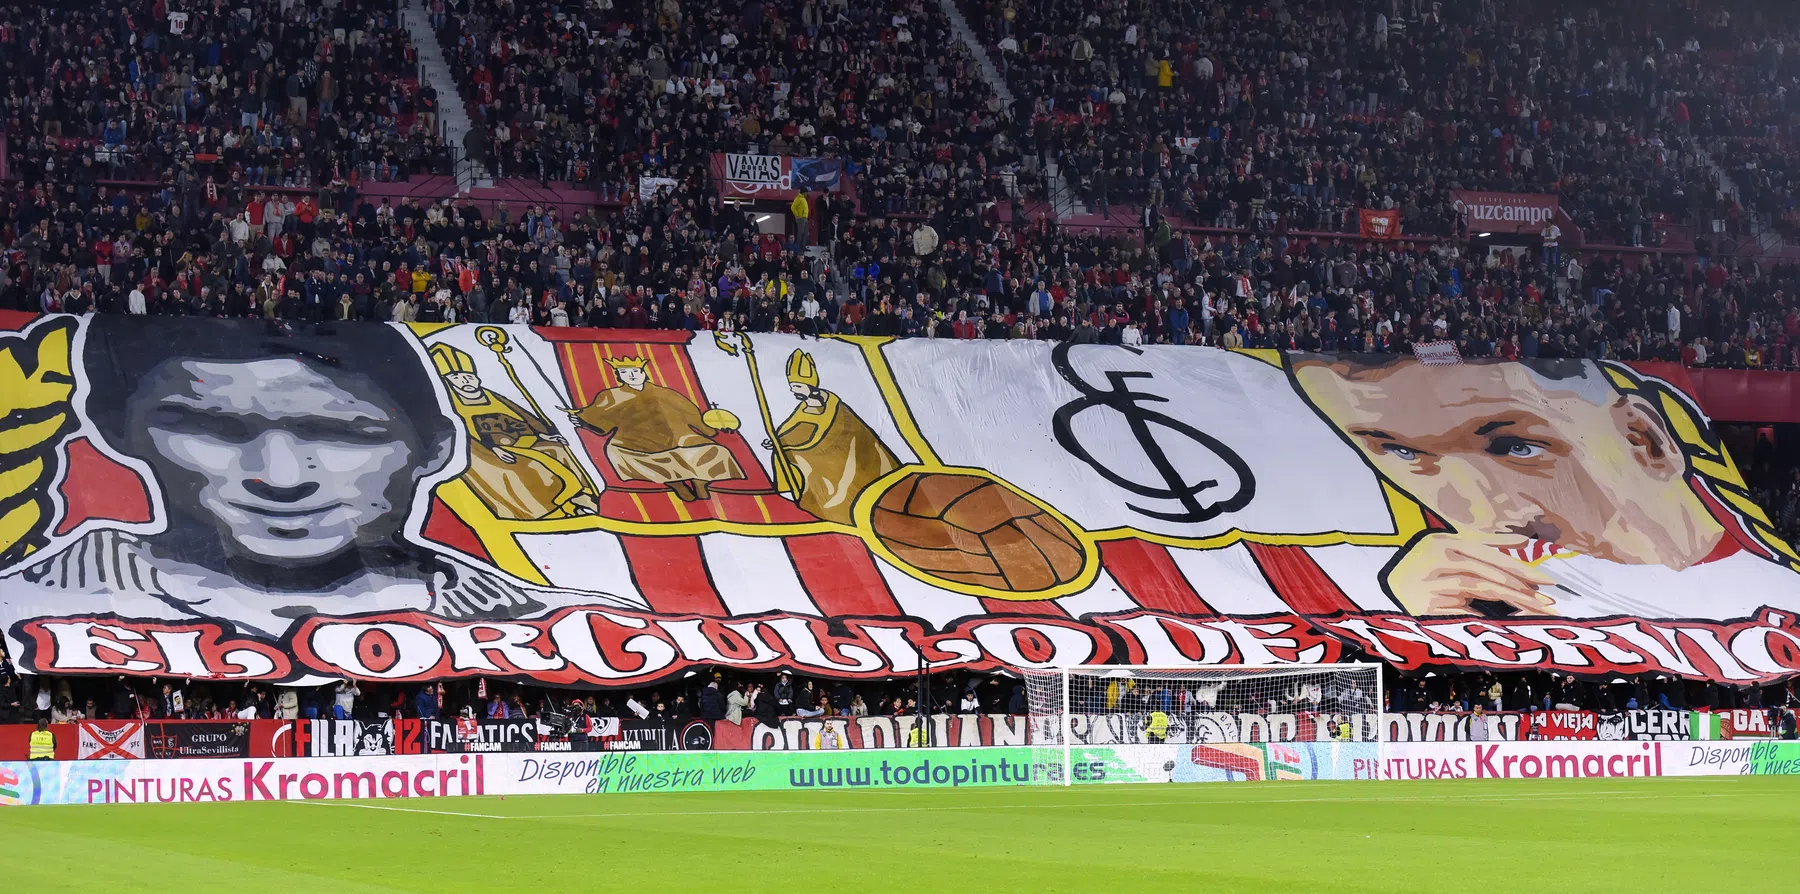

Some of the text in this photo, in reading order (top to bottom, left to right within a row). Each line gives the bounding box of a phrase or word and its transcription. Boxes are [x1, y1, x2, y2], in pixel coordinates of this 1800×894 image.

[41, 621, 274, 679] EL
[312, 609, 1097, 680] ORGULLO
[1108, 613, 1328, 667] DE
[191, 733, 227, 743] GRUPO
[295, 718, 353, 757] FILA
[1551, 713, 1593, 733] VIEJA
[179, 744, 239, 755] UltraSevillista
[464, 741, 502, 752] #FANCAM
[534, 741, 572, 752] #FANCAM
[604, 740, 642, 751] #FANCAM
[1689, 740, 1778, 771] Disponible
[518, 751, 636, 786] Disponible
[790, 757, 1106, 787] www.todopinturaes
[1353, 742, 1662, 780] PINTURAS Kromacril
[1740, 762, 1759, 775] en
[88, 754, 484, 803] PINTURAS Kromacril
[585, 760, 757, 794] en nuestra web
